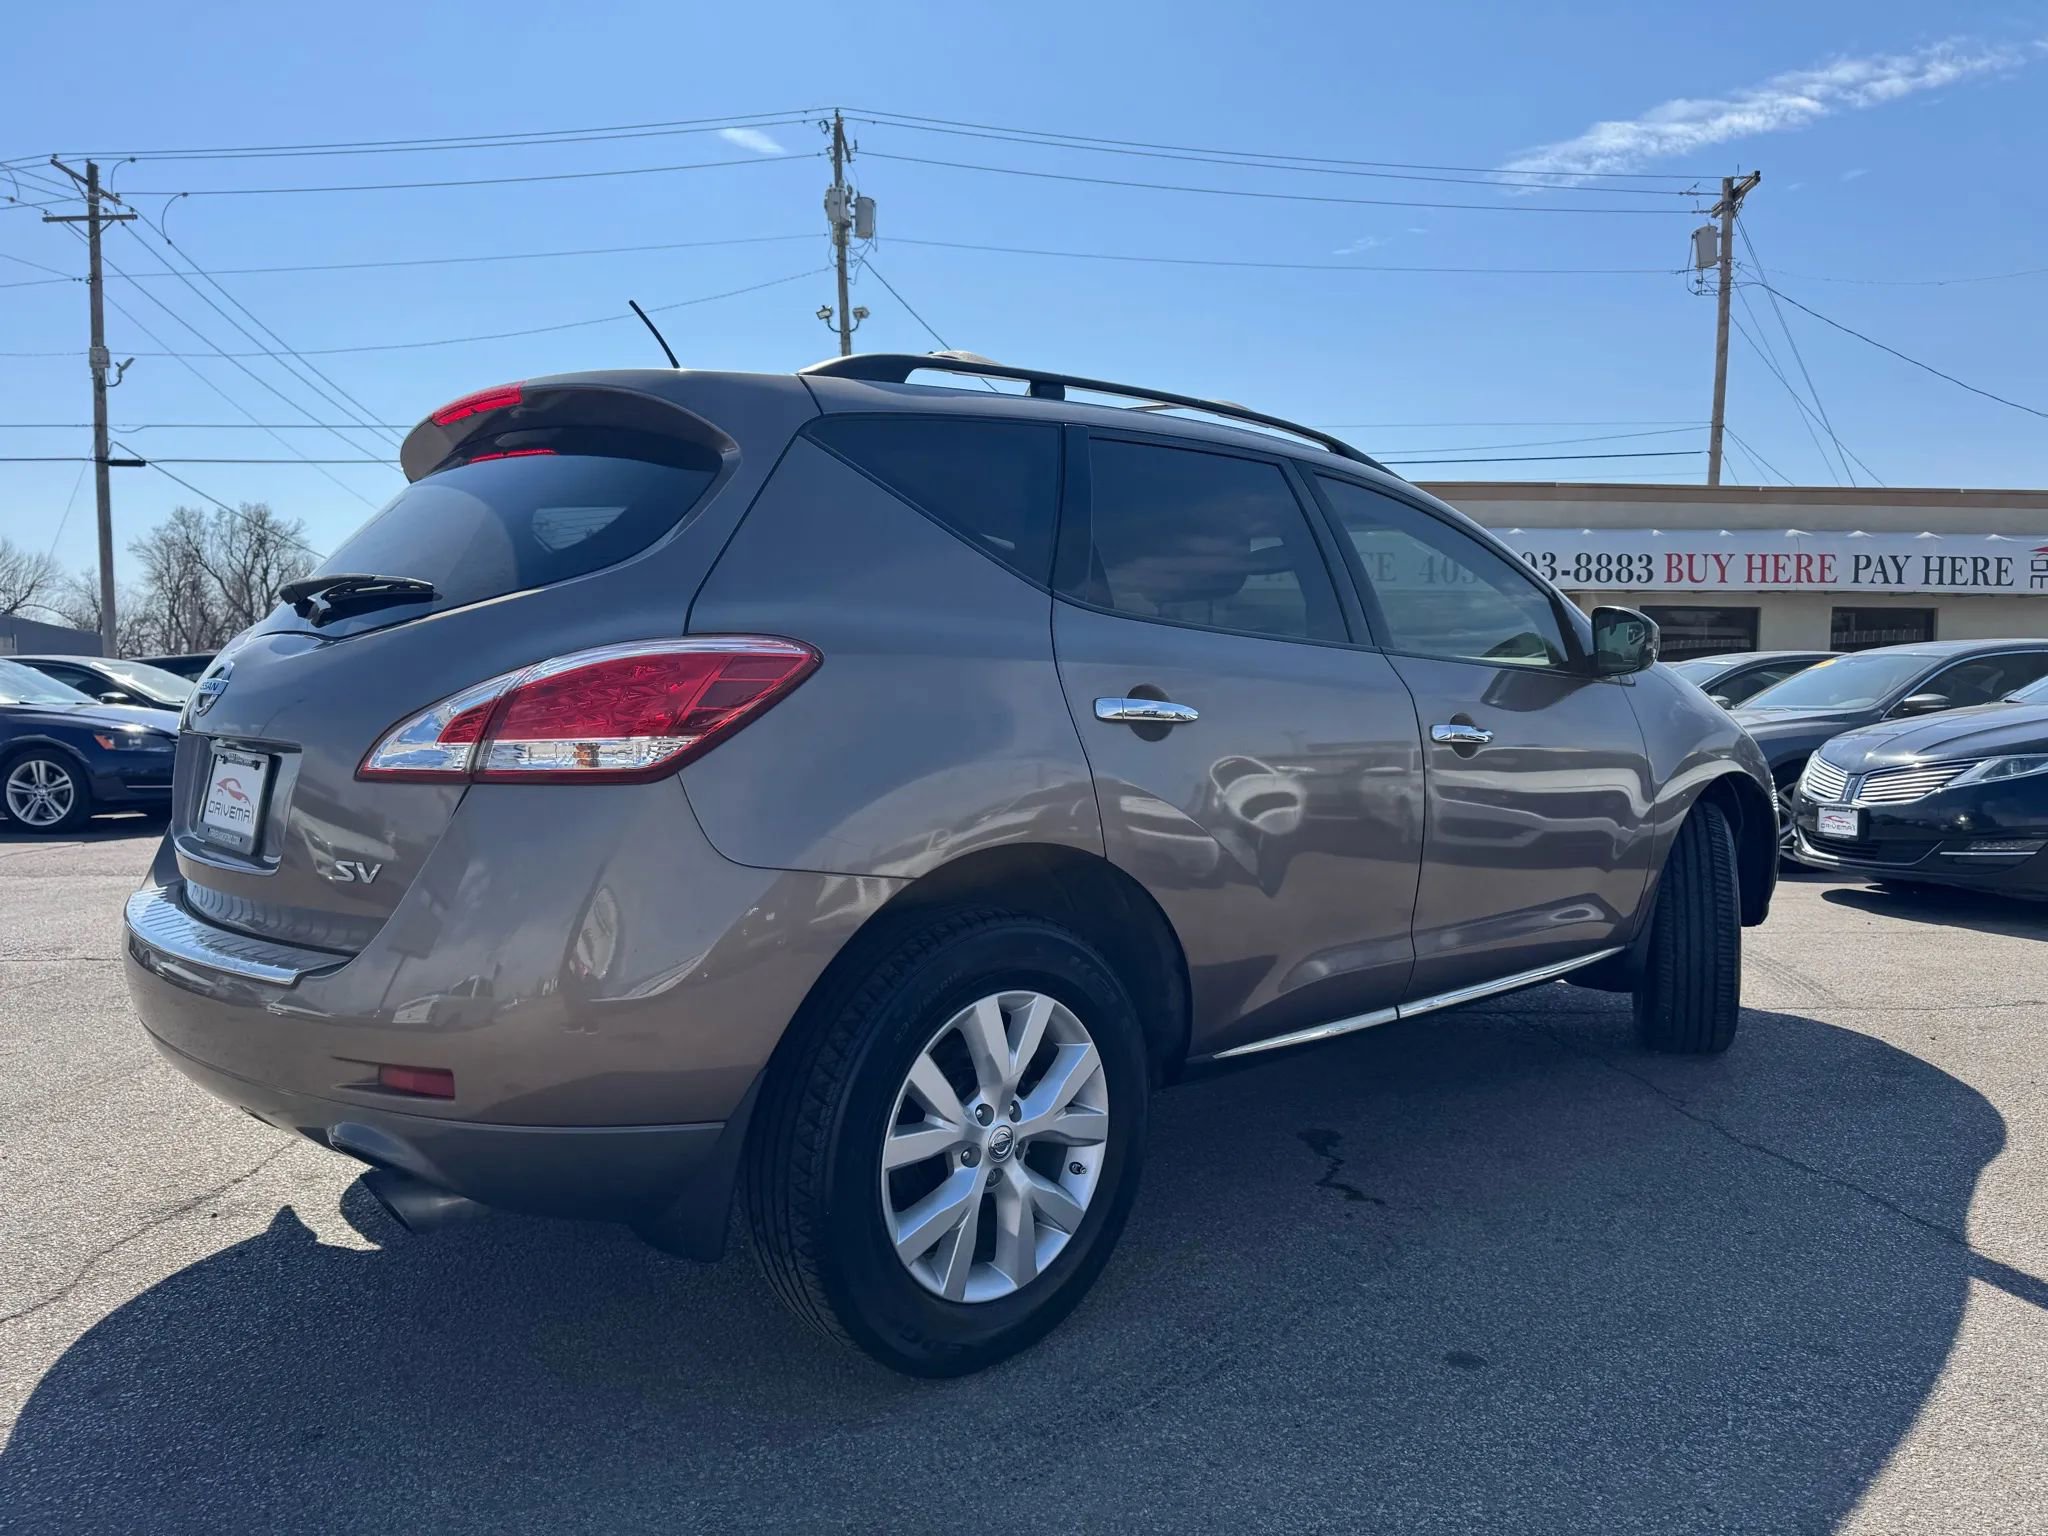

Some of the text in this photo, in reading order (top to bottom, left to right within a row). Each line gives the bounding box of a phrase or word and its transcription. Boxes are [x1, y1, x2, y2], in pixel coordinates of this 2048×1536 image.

[1663, 553, 1735, 583] BUY
[1744, 553, 1838, 584] HERE
[1851, 554, 1912, 584] PAY
[1921, 555, 2014, 587] HERE
[334, 860, 382, 885] SV
